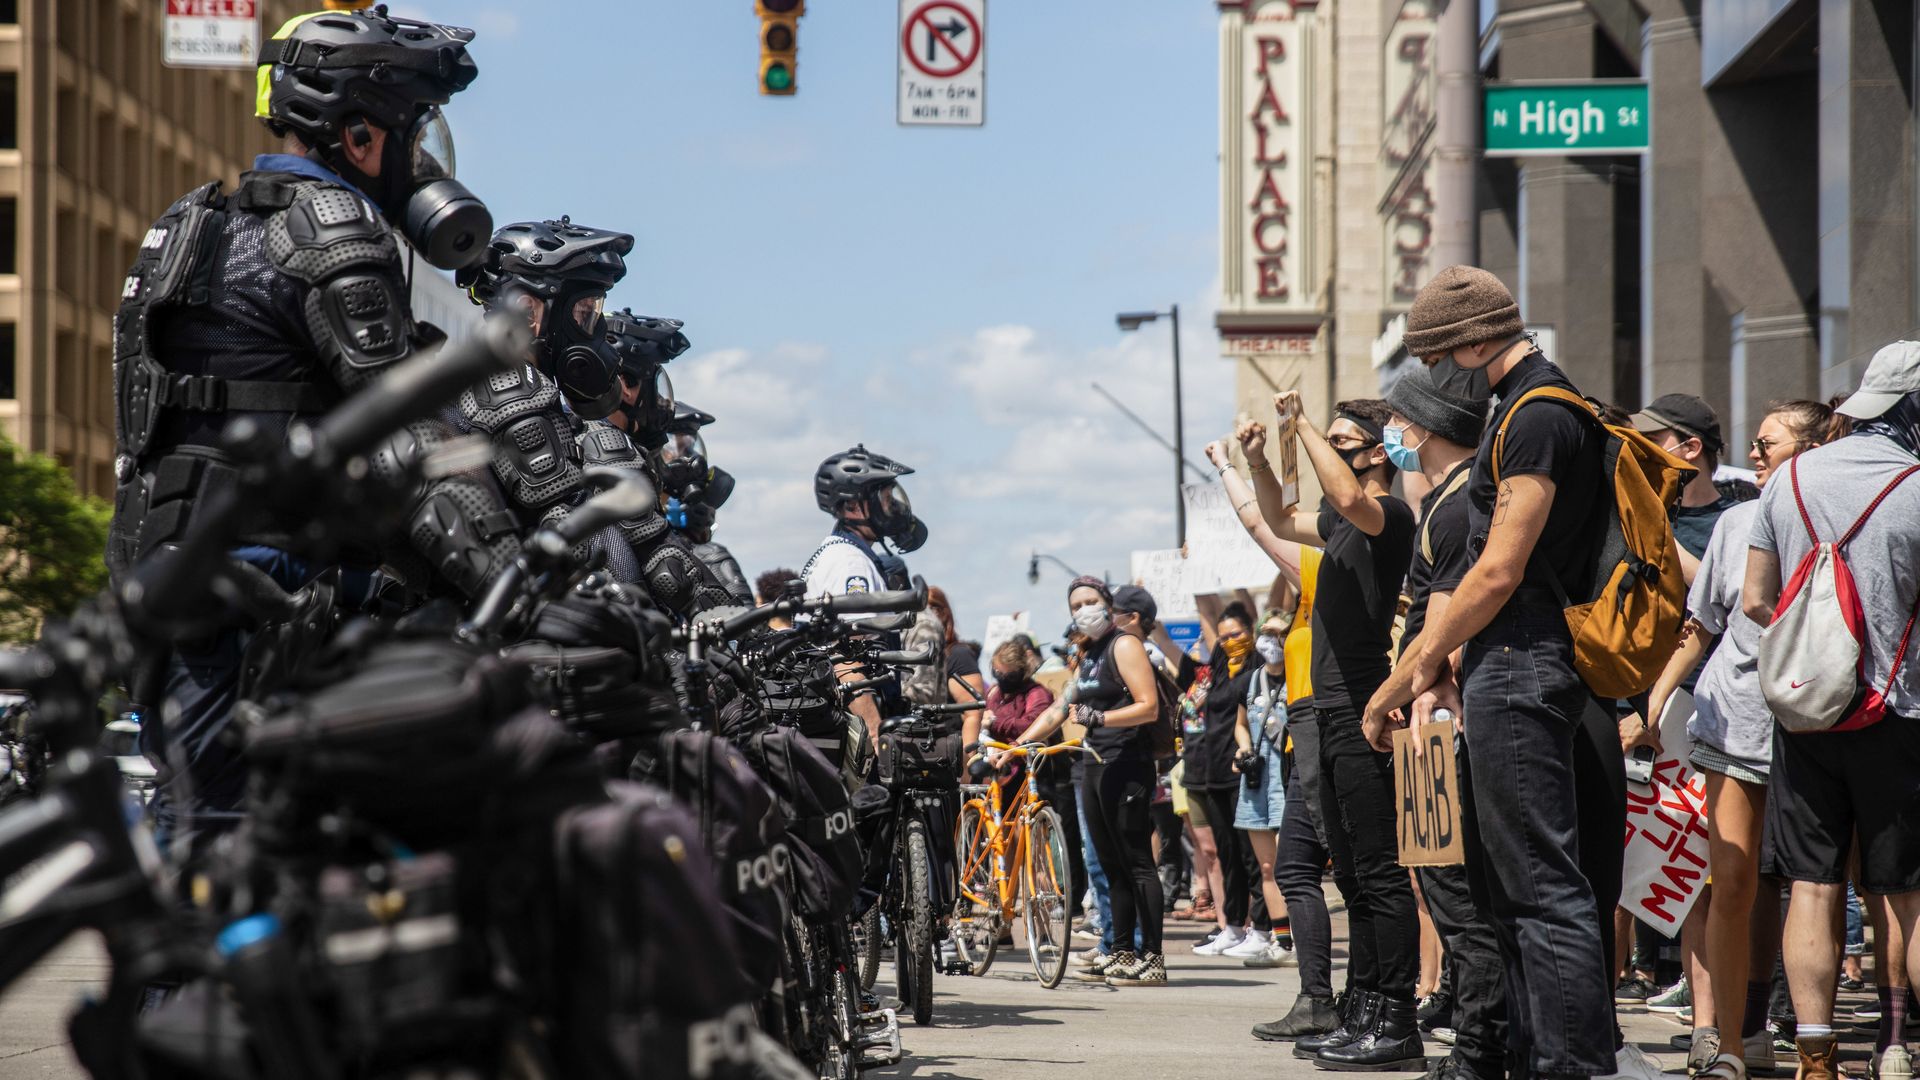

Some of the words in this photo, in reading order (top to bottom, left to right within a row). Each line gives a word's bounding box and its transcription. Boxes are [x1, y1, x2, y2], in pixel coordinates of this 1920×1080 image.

[1493, 108, 1508, 127] N
[1519, 99, 1605, 145] High
[1617, 106, 1639, 127] St
[1251, 35, 1289, 298] PALACE
[1227, 337, 1313, 353] THEATRE
[1402, 735, 1452, 851] ACAB
